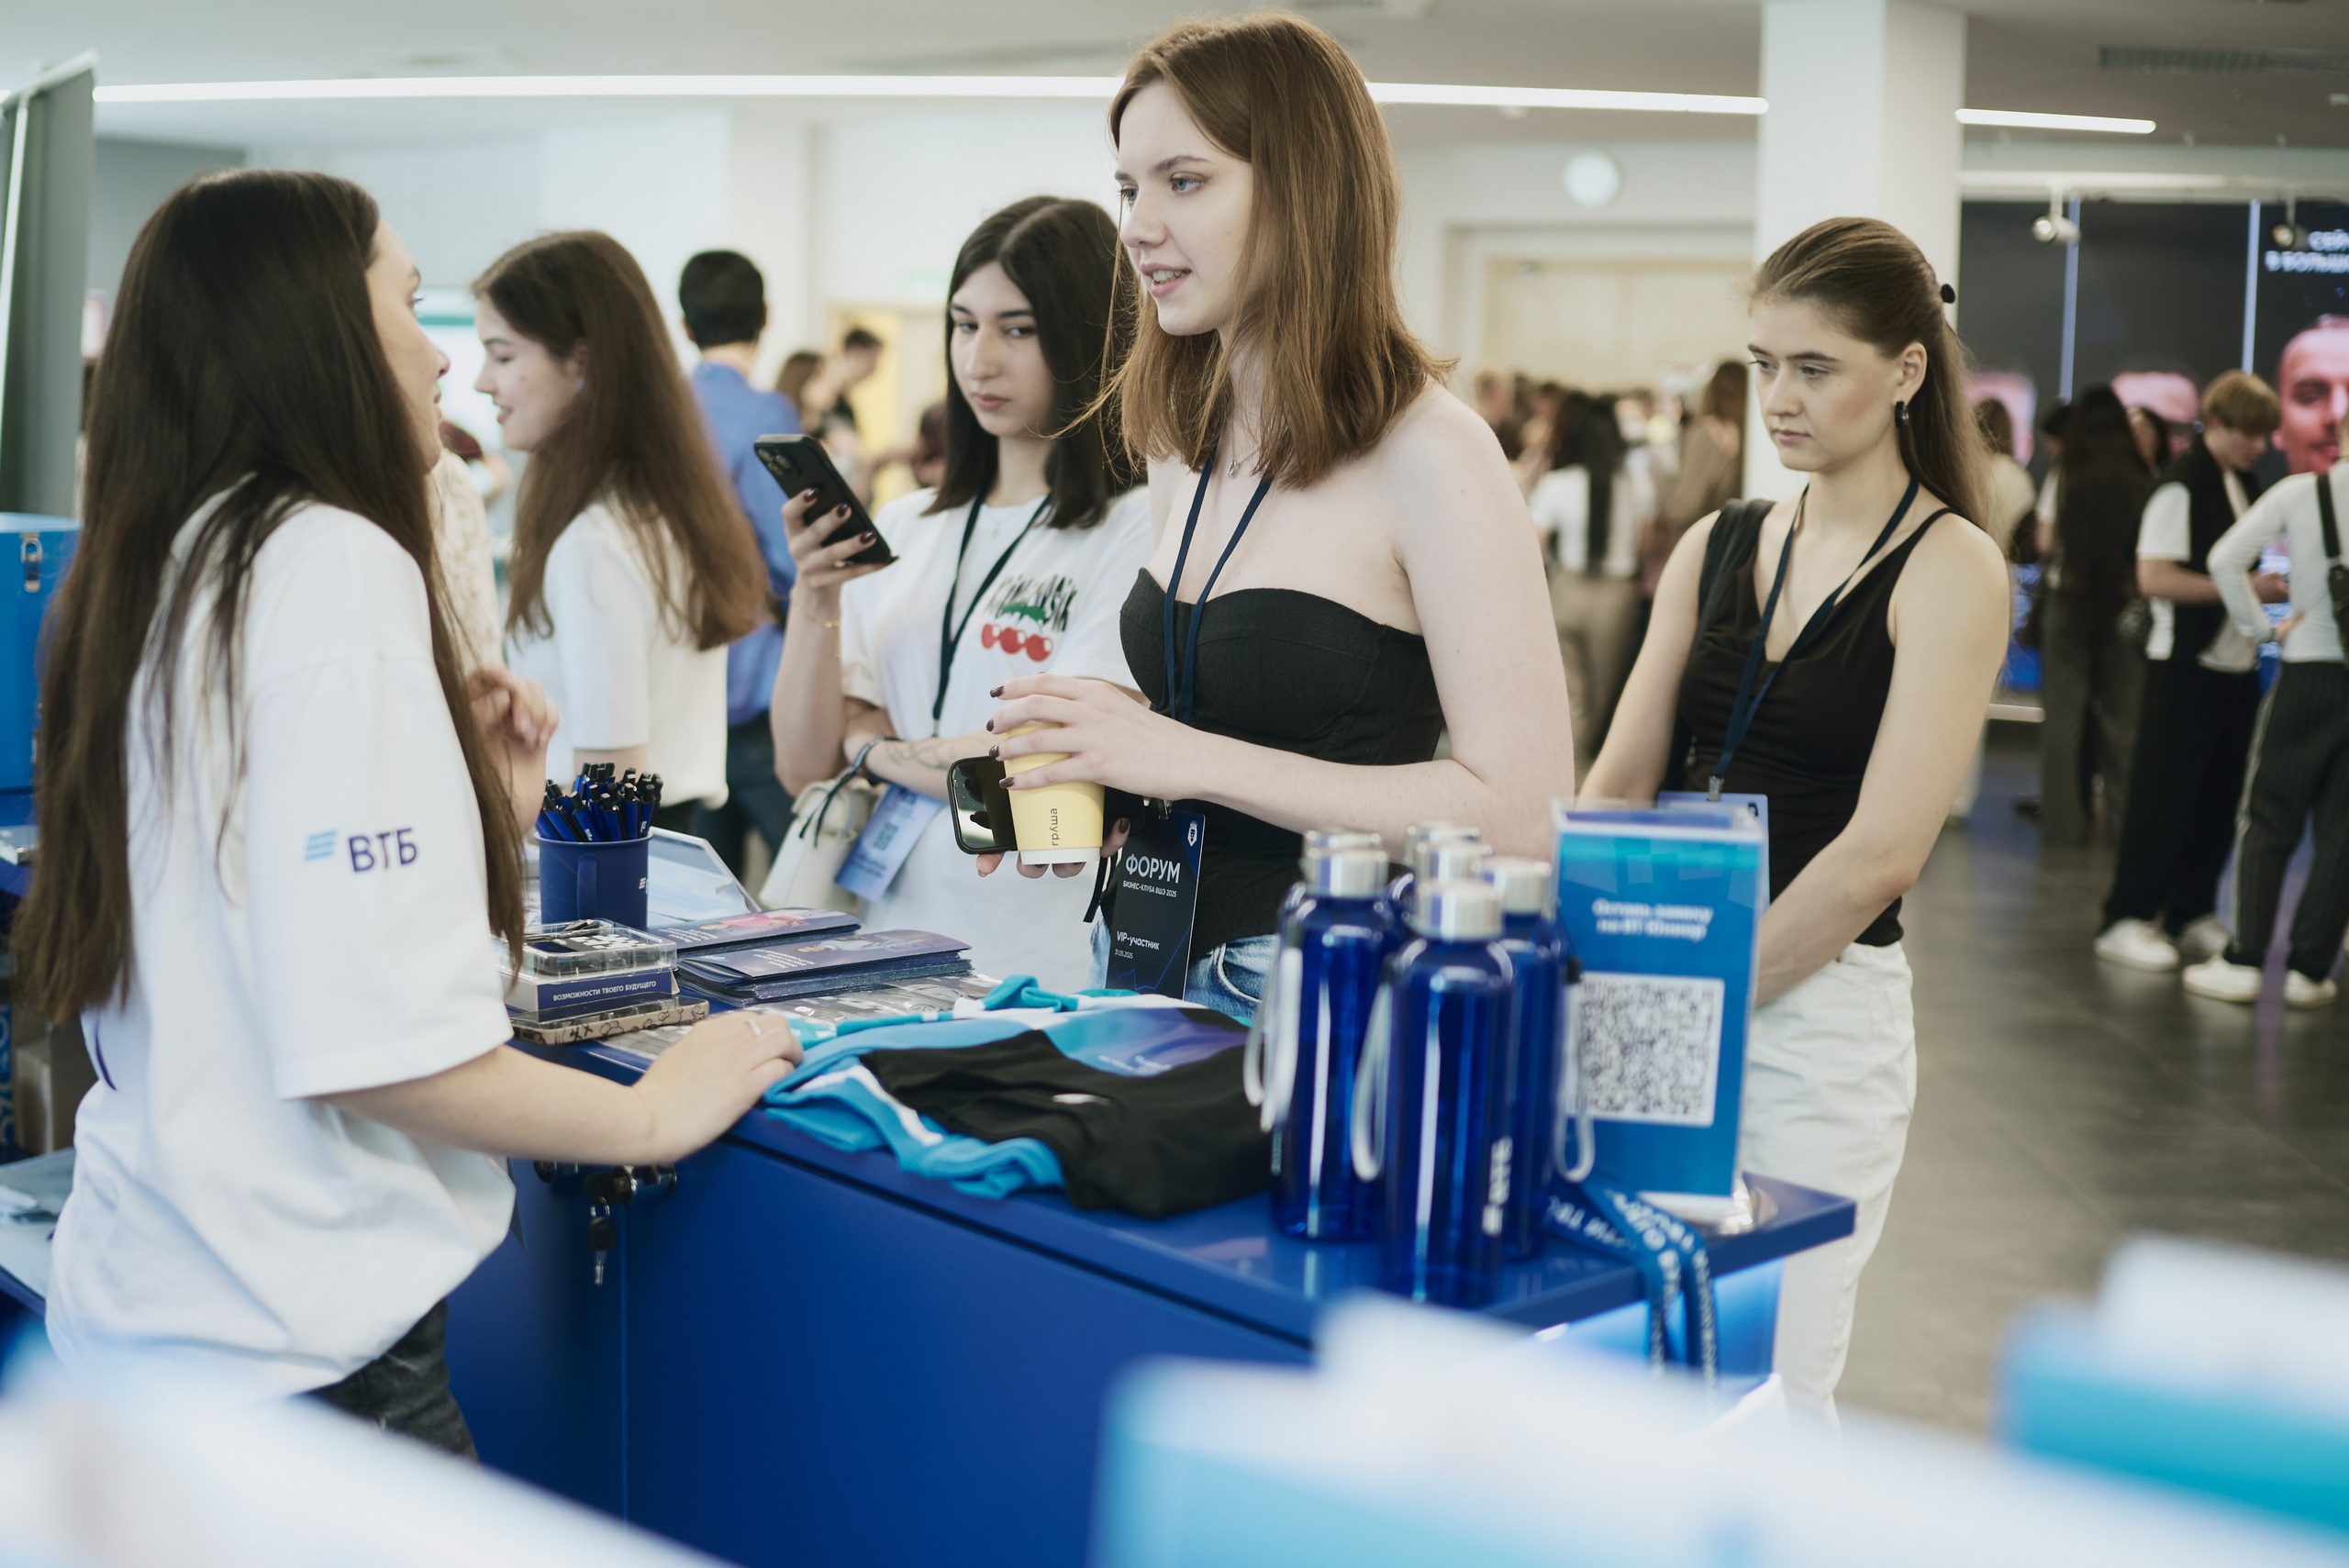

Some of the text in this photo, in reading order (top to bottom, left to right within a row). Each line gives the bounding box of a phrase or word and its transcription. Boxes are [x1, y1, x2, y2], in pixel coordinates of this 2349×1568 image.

[349, 828, 417, 872] ВТБ
[1125, 853, 1181, 884] ФОРУМ
[1123, 880, 1177, 898] БИЗНЕС-КЛУБА ВШЭ 2025
[1117, 930, 1160, 951] VIP-участник
[552, 980, 657, 1001] ВОЗМОЖНОСТИ ТВОЕГО БУДУЩЕГО
